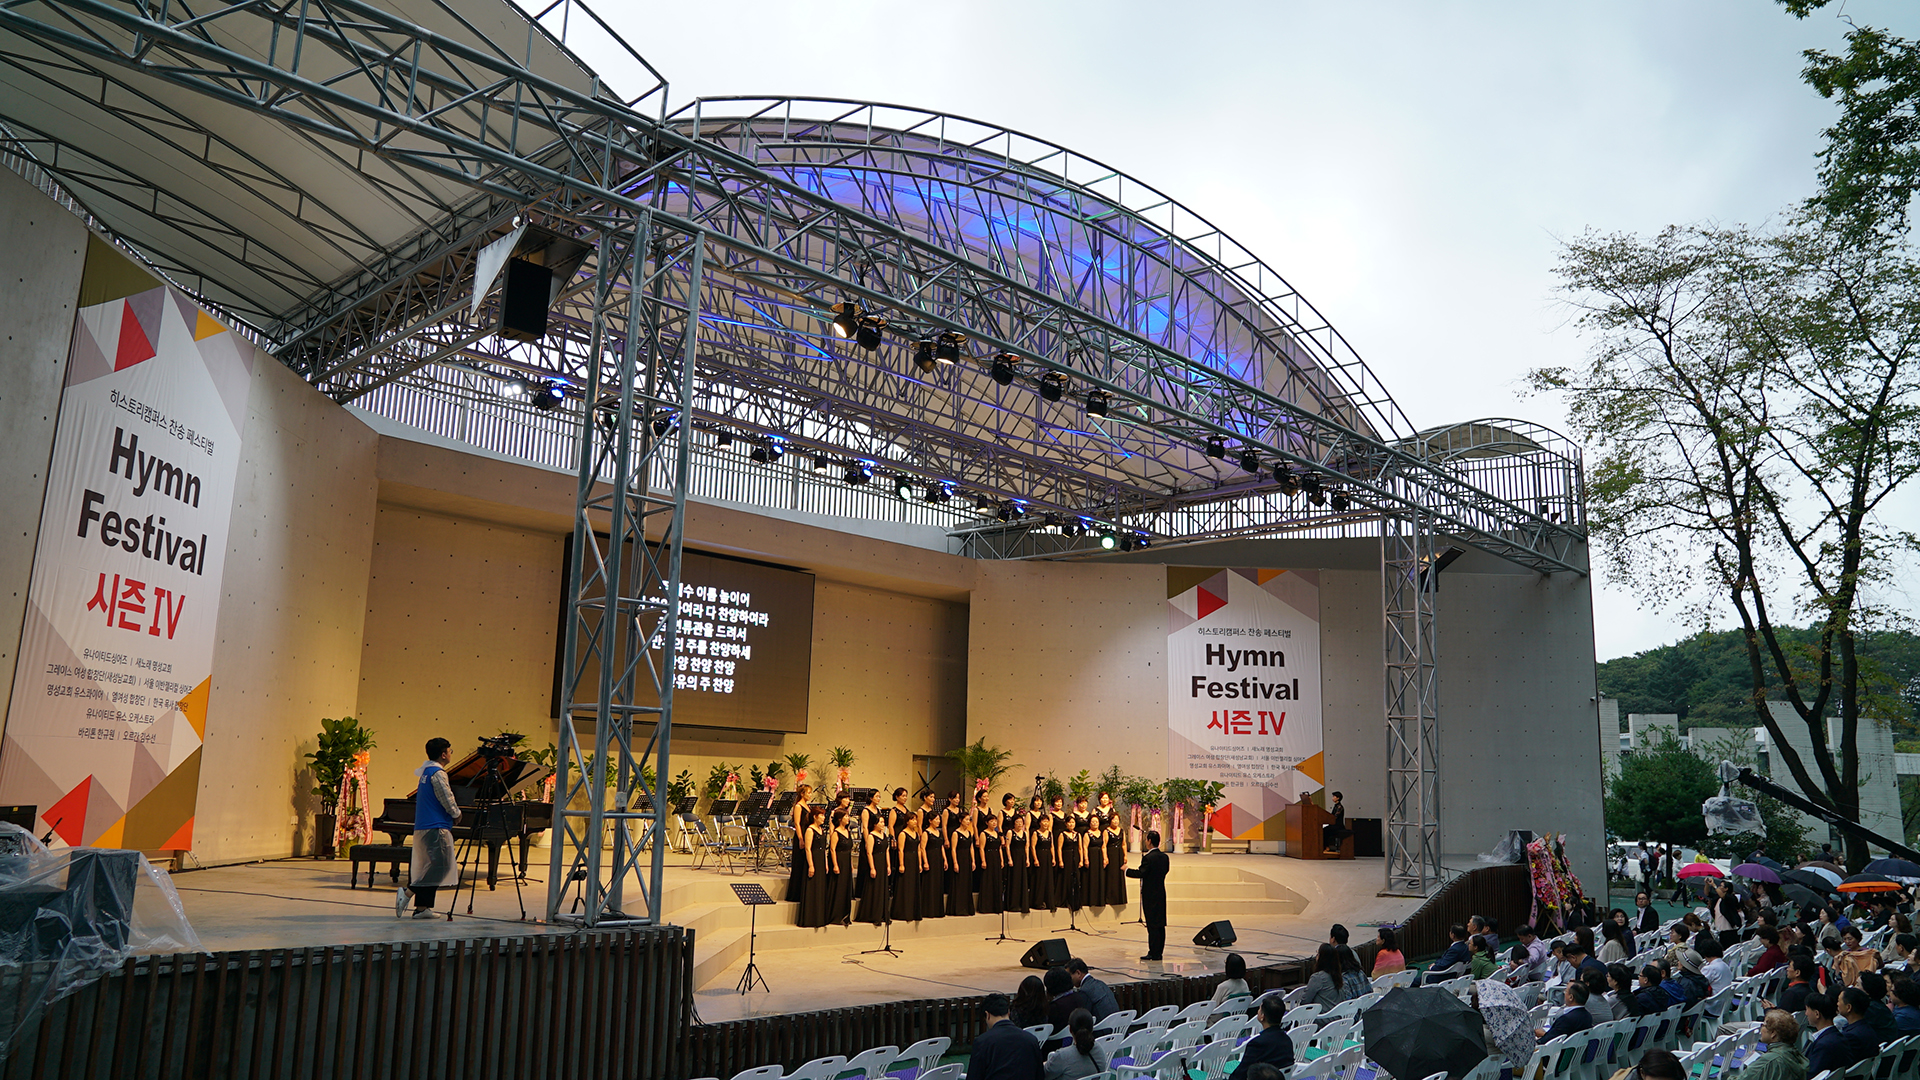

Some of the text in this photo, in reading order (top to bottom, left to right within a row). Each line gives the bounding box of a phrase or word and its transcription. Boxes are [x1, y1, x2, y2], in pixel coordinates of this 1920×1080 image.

[110, 389, 215, 456] 히스토리캠퍼스 찬송 페스티벌
[109, 426, 201, 508] Hymn
[77, 488, 207, 576] Festival
[86, 572, 146, 632] 시즌
[696, 586, 717, 602] 이름
[719, 589, 750, 607] 높이어
[705, 605, 716, 620] 다
[718, 606, 769, 628] 찬양하여라
[715, 624, 747, 642] 드려서
[1198, 627, 1291, 638] 히스토리캠퍼스 찬송 페스티벌
[686, 638, 707, 655] 주를
[709, 641, 751, 660] 찬양하세
[1206, 643, 1285, 672] Hymn
[46, 663, 72, 676] 그레이스
[74, 667, 86, 679] 여성
[144, 677, 154, 689] 서울
[690, 657, 712, 673] 찬양
[713, 659, 735, 676] 찬양
[46, 684, 72, 697] 명성교회
[74, 686, 103, 700] 유스콰이어
[699, 676, 711, 692] 주
[712, 677, 734, 694] 찬양
[1191, 675, 1299, 700] Festival
[86, 707, 155, 725] 유나이티드 유스 오케스트라
[1207, 709, 1253, 735] 시즌
[78, 727, 96, 739] 바리톤
